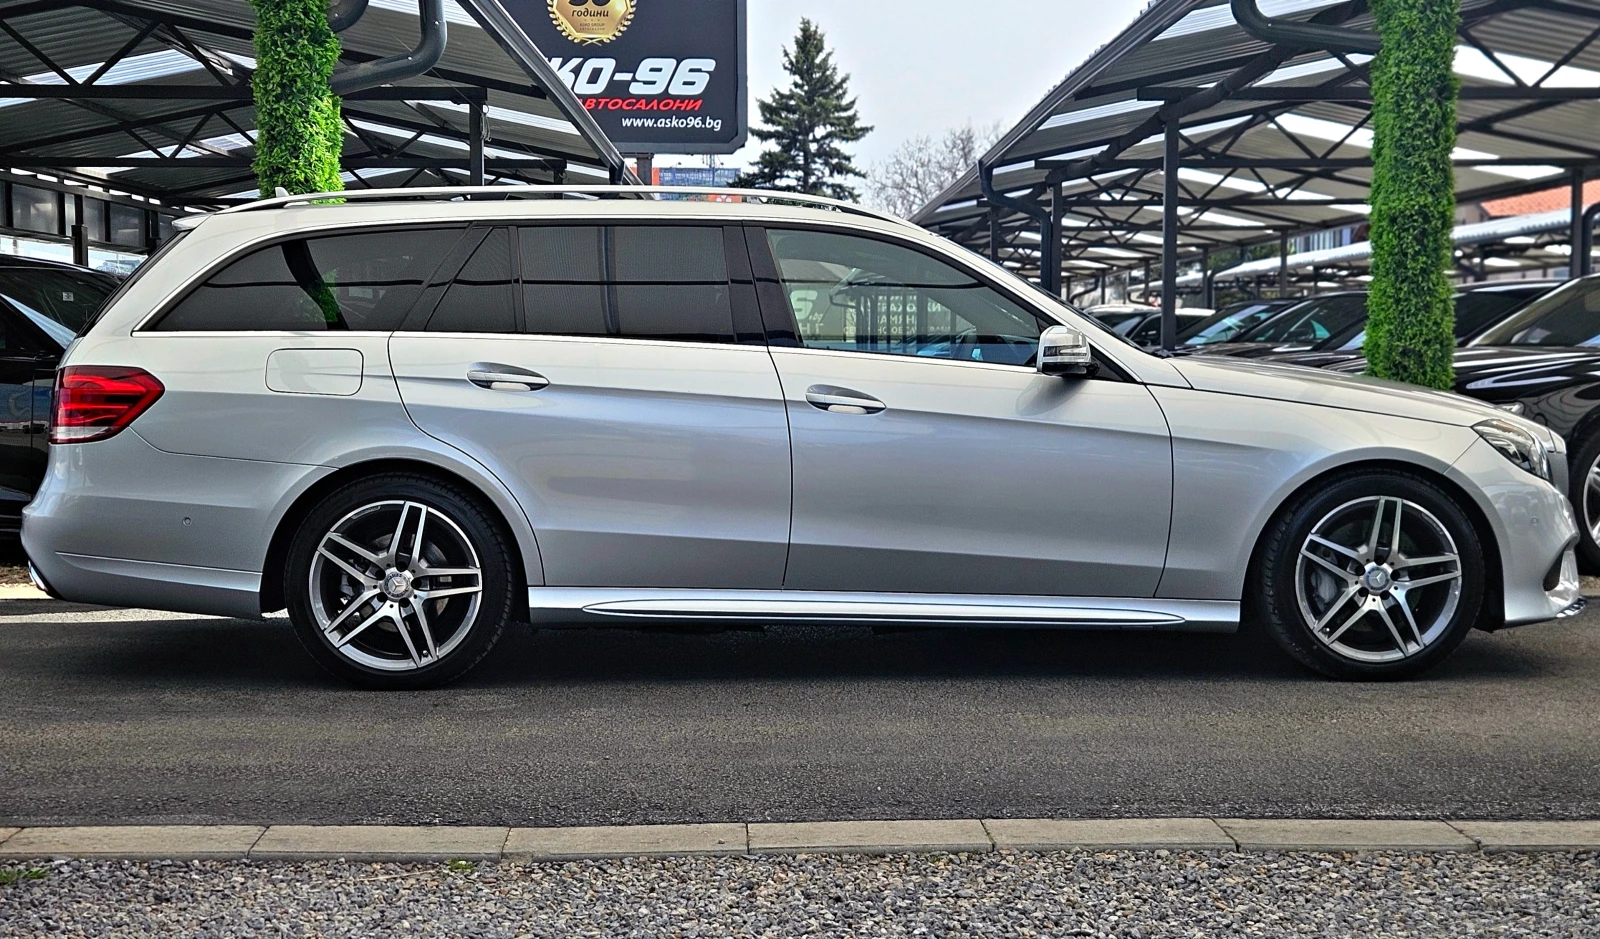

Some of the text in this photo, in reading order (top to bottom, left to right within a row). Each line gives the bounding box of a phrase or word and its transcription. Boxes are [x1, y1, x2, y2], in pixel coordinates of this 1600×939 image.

[571, 8, 609, 17] години
[545, 57, 717, 96] KO-96
[578, 97, 704, 111] ВТОСАЛОНИ
[621, 115, 722, 131] www.asko96.bg
